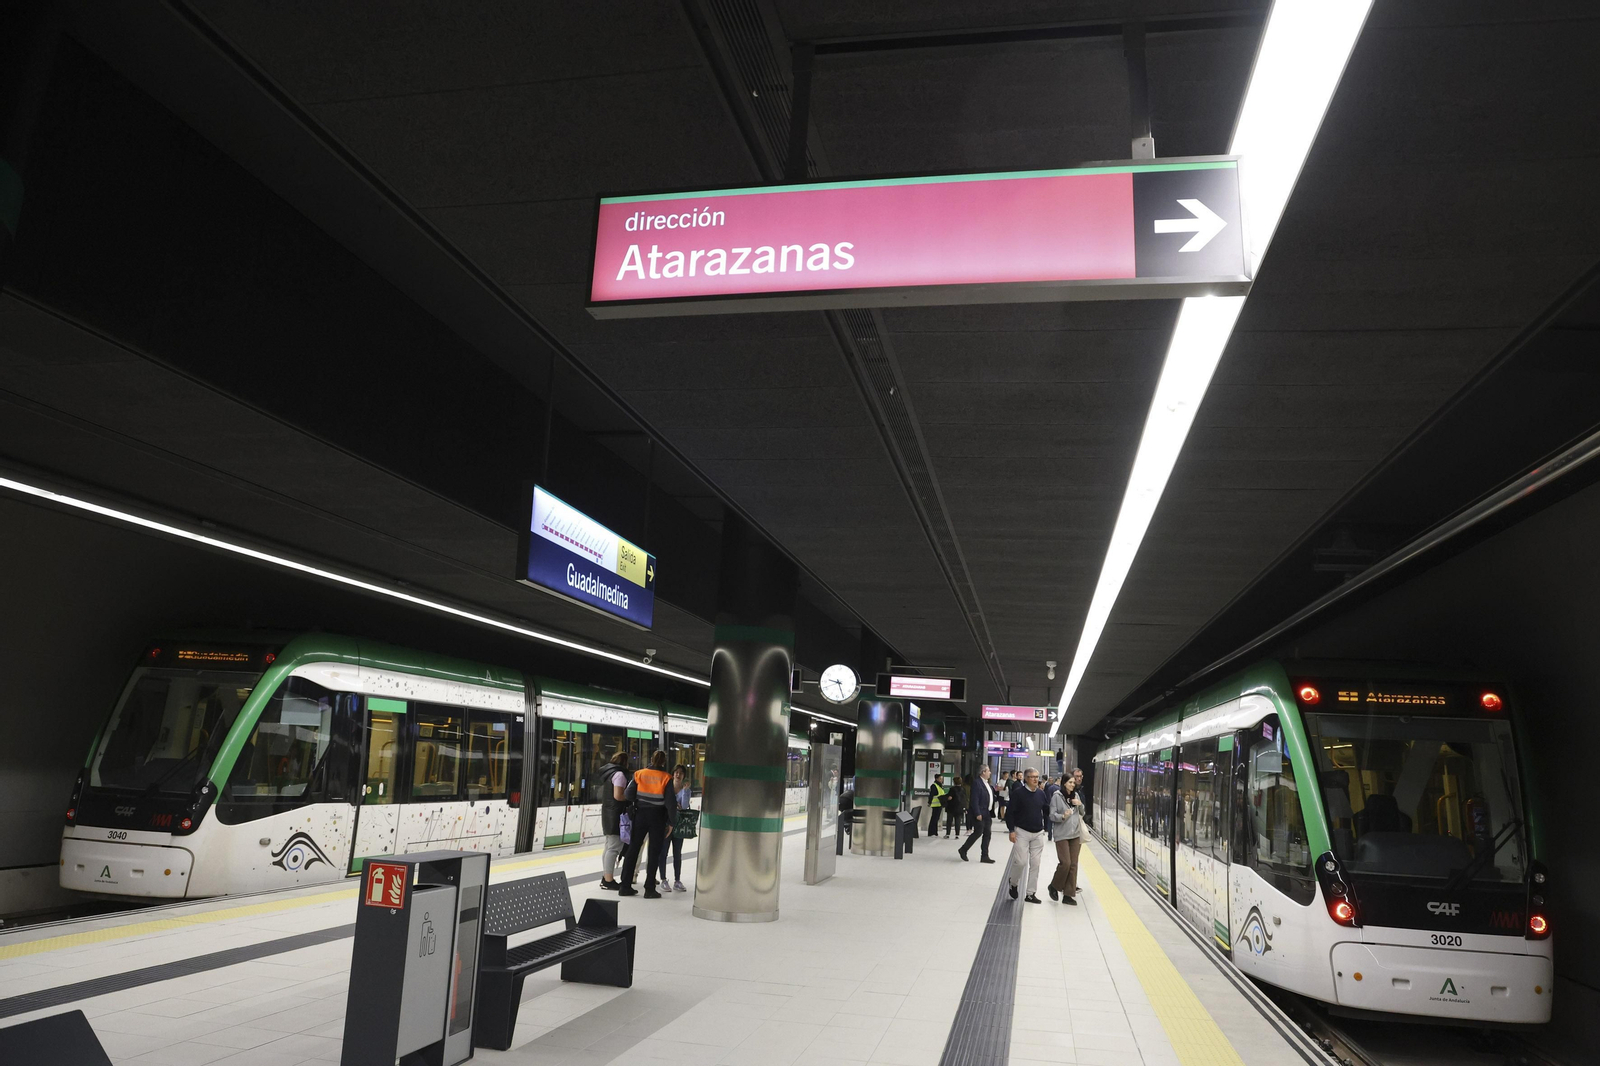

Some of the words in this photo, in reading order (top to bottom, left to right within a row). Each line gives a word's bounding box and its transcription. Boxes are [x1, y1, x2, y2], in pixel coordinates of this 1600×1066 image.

[624, 206, 725, 232] dirección
[616, 239, 855, 281] Atarazanas
[621, 545, 636, 565] Salida
[566, 562, 629, 610] Guadalmedina
[114, 805, 136, 816] CAF
[107, 830, 127, 840] 3040
[1426, 901, 1460, 916] CAF
[1430, 934, 1462, 947] 3020
